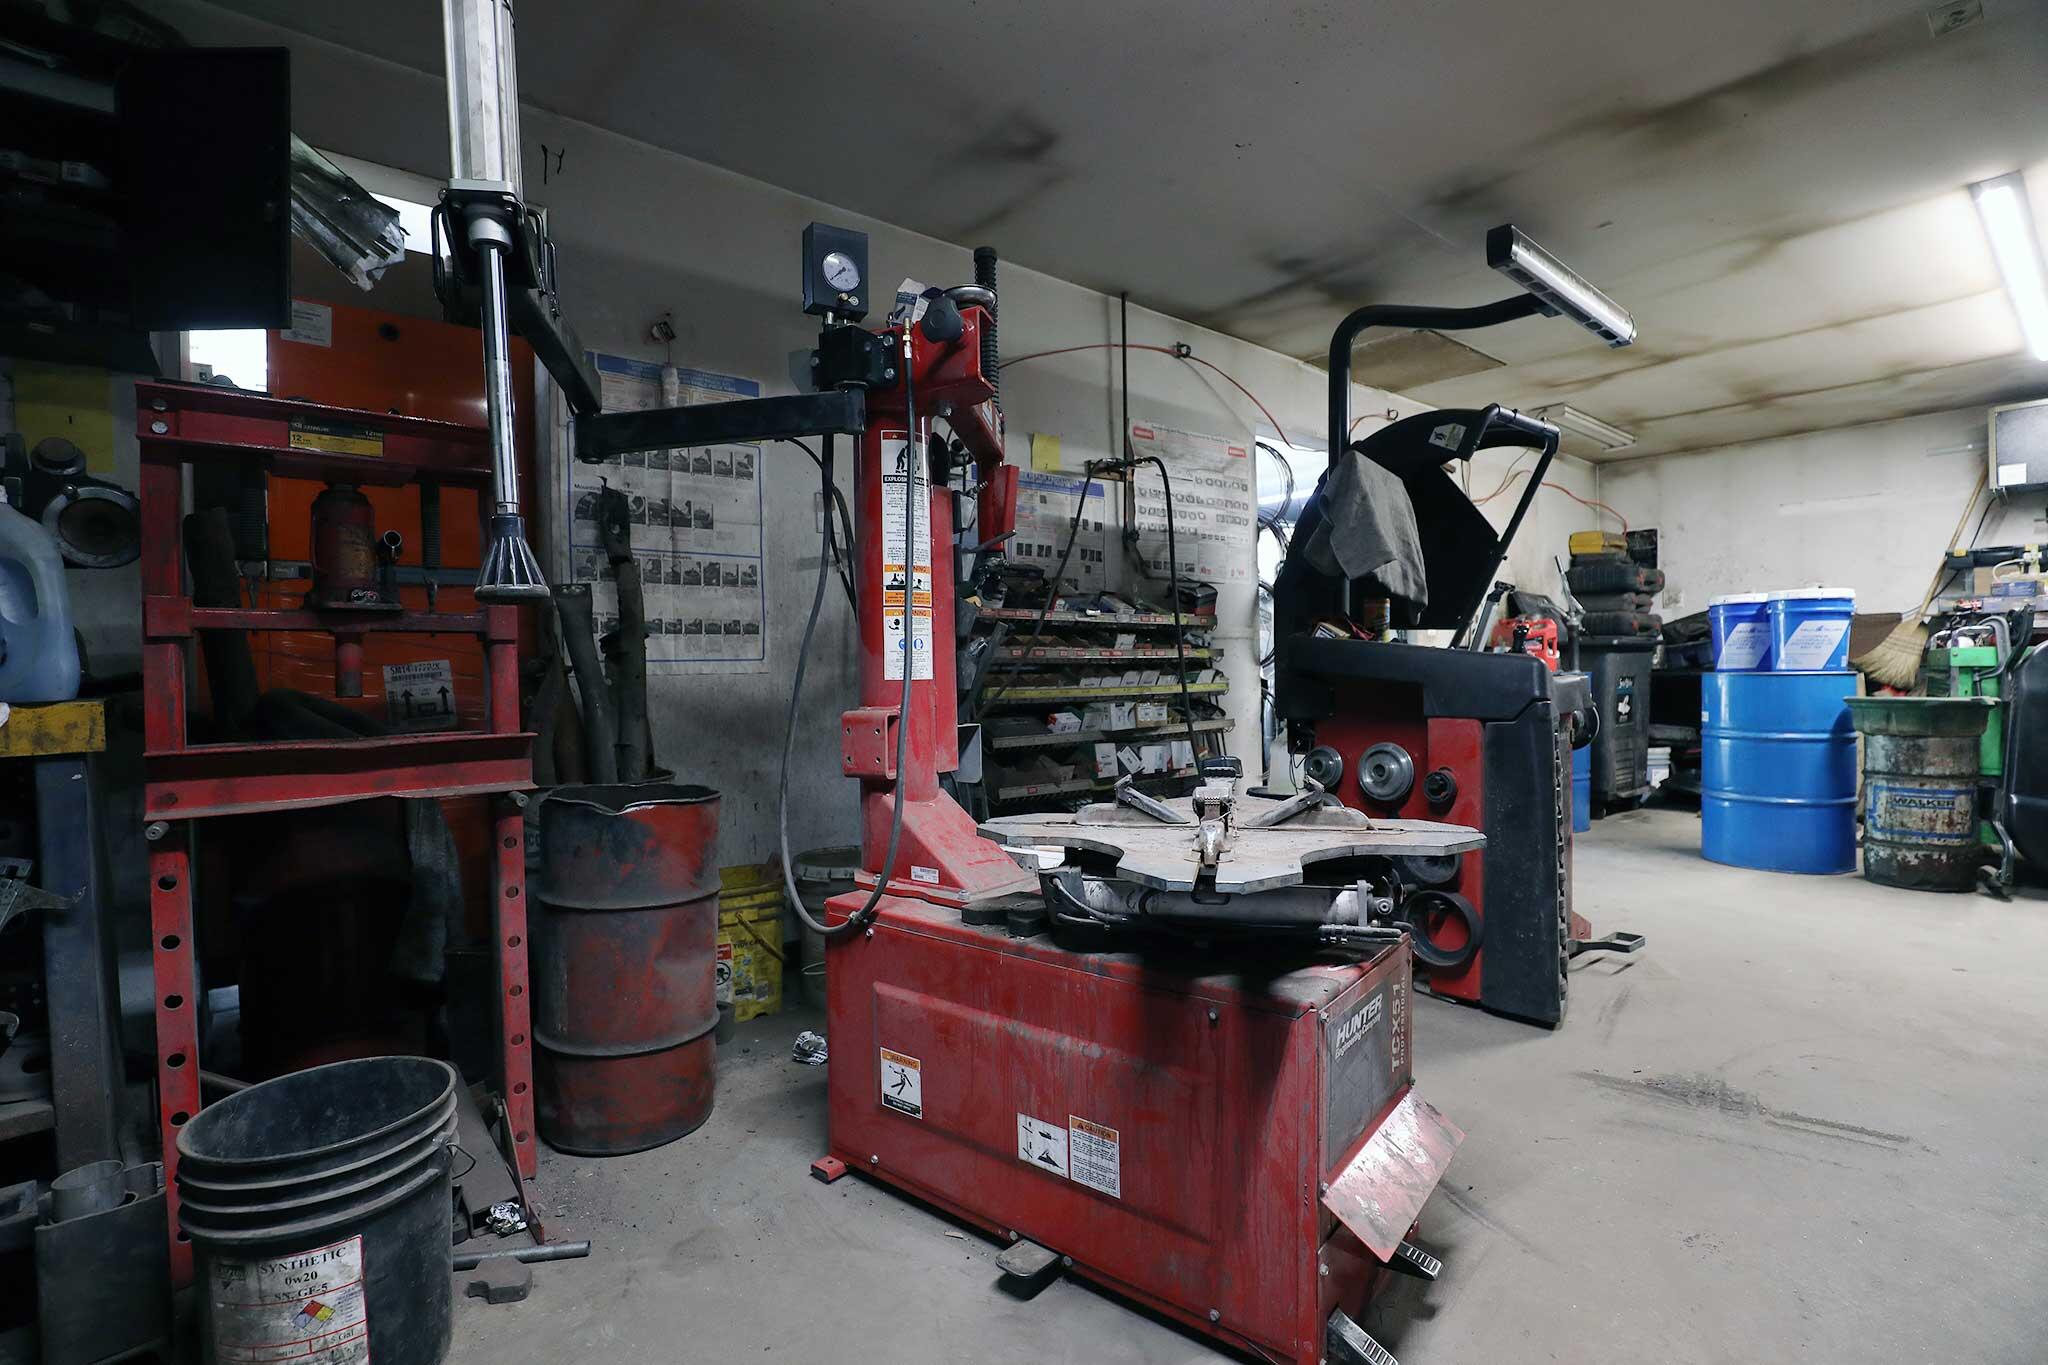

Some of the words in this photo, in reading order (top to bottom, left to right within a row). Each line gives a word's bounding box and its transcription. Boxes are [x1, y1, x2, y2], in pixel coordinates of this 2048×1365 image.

[1894, 797, 1956, 808] WALKER
[1336, 992, 1384, 1048] HUNTER
[1391, 984, 1401, 1073] TCX51
[1335, 1029, 1362, 1061] Engineering
[1085, 1125, 1112, 1140] CAUTION
[260, 1247, 346, 1274] SYNTHETIC
[284, 1270, 318, 1286] 0w20
[297, 1282, 329, 1297] GF-5
